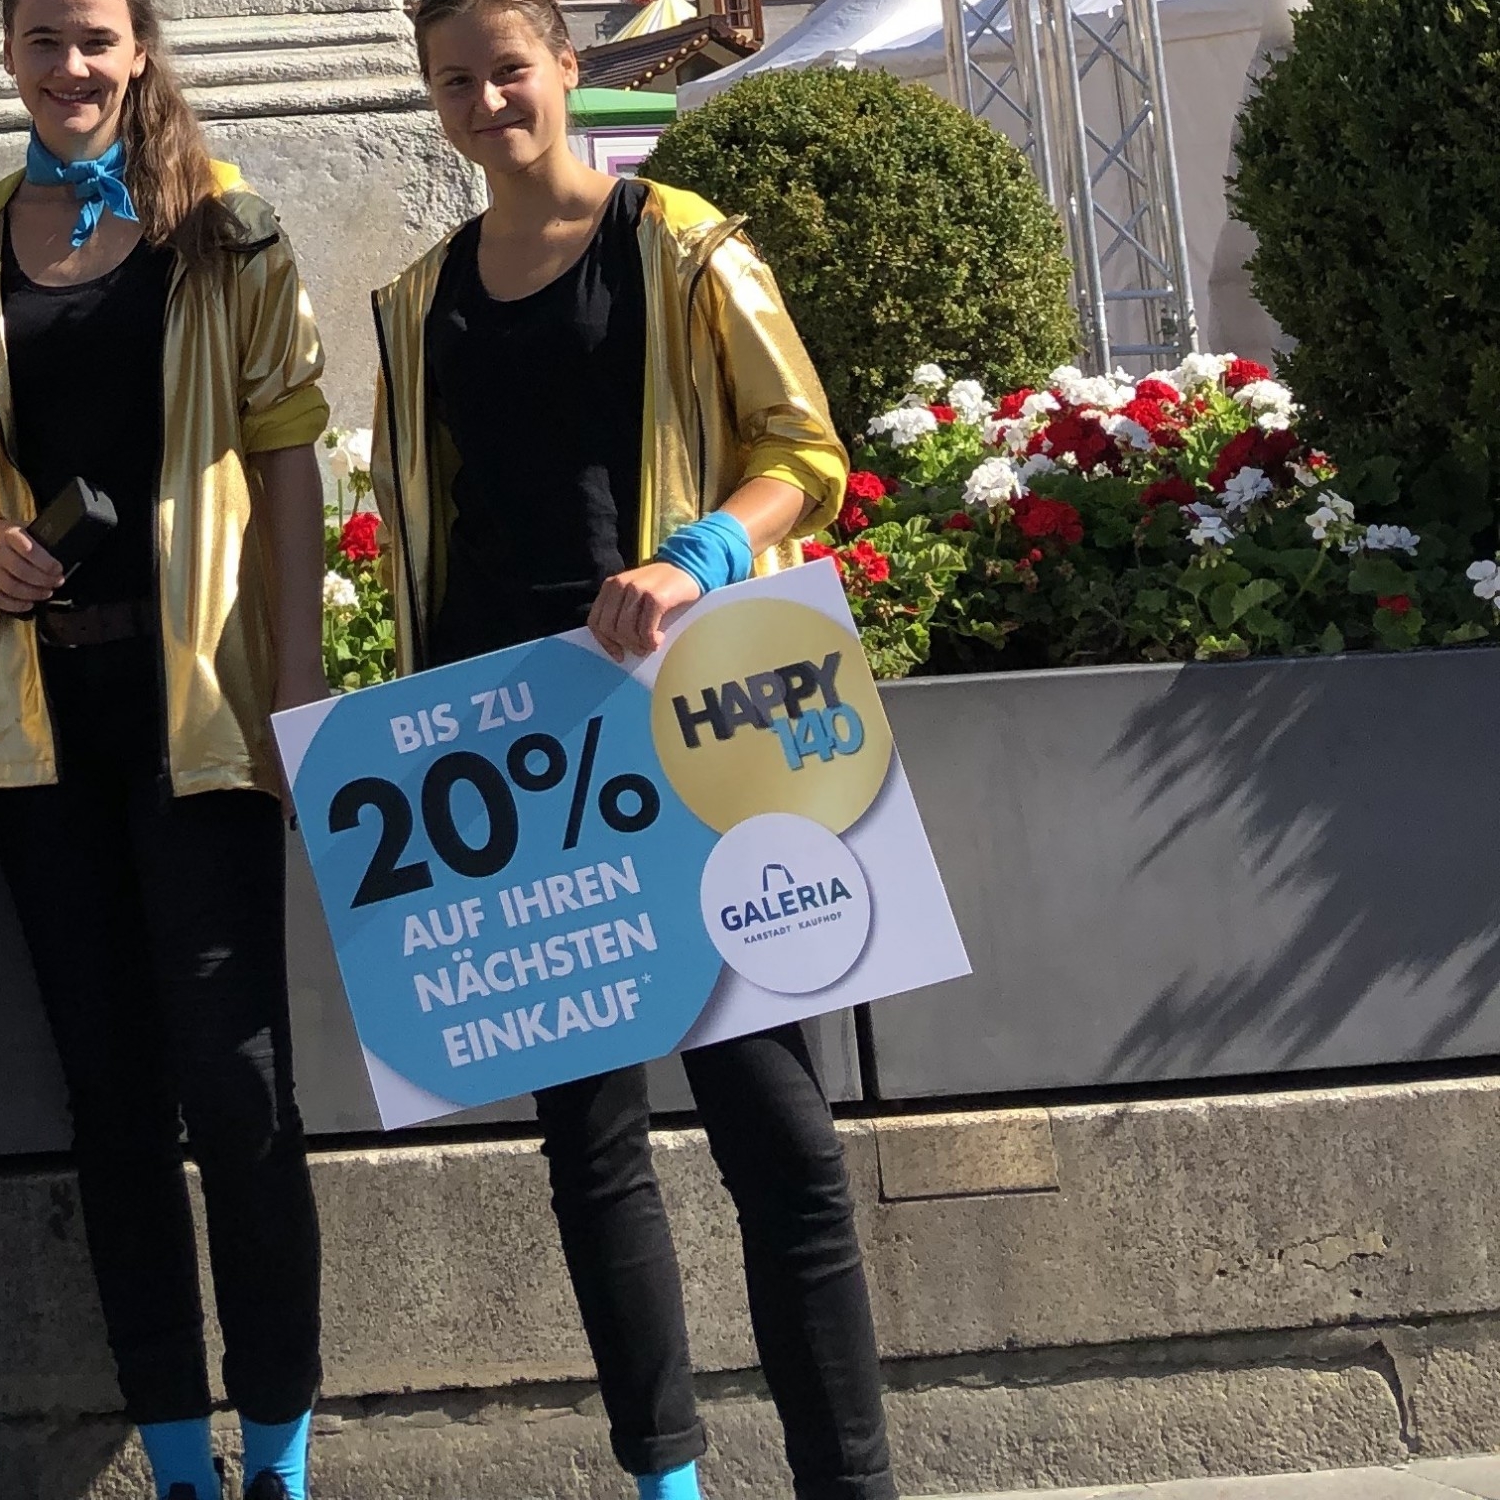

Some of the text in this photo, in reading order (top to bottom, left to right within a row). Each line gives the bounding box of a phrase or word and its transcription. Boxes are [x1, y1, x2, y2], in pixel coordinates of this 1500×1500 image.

[388, 681, 535, 754] BIS ZU
[672, 651, 844, 749] HAPPY
[770, 703, 865, 771] 140
[328, 714, 660, 909] 20%
[402, 856, 641, 957] AUF IHREN
[721, 877, 852, 931] GALERIA
[744, 911, 842, 944] KARSTADT KAUFHOF
[413, 912, 659, 1013] NÄCHSTEN
